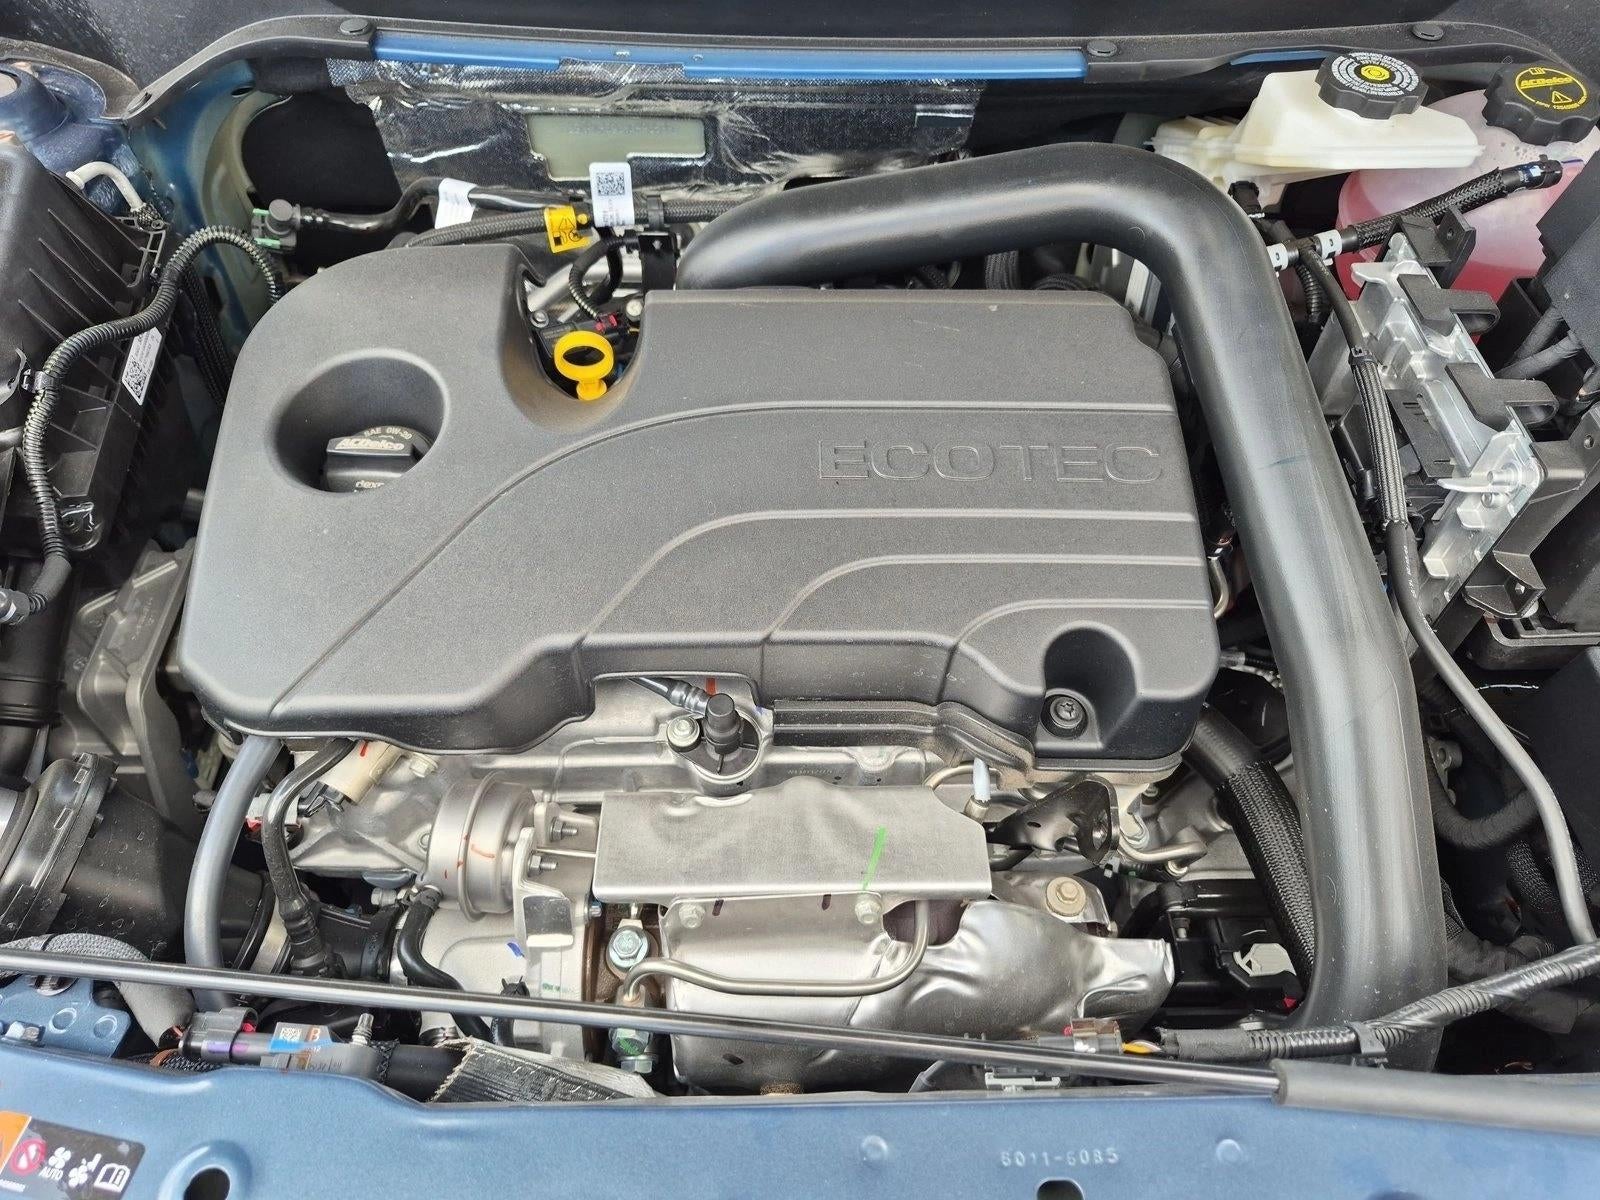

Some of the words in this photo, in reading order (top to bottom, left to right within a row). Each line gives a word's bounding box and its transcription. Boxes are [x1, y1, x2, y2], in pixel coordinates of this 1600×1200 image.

[364, 427, 382, 437] SAE
[386, 427, 413, 439] 0W-20
[335, 438, 405, 451] ACDelco
[818, 439, 1163, 484] ECOTEC
[38, 1166, 64, 1181] AUTO
